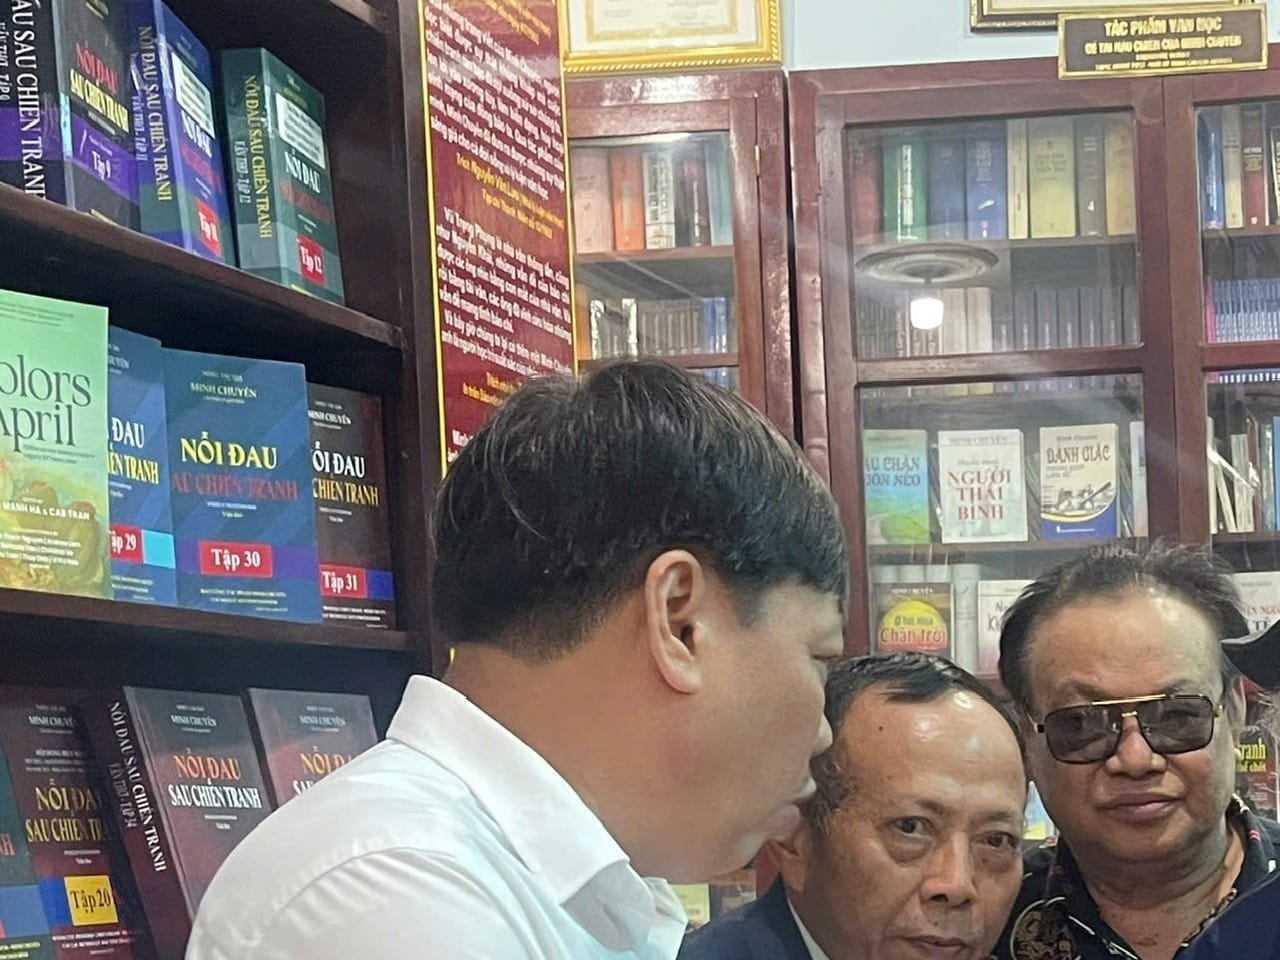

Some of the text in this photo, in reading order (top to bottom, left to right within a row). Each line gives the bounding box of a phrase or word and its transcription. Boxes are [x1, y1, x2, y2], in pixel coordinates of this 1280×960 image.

[1105, 20, 1128, 37] TÁC
[1130, 16, 1167, 35] PHẨM
[1196, 17, 1222, 34] HỌC
[13, 30, 37, 69] SAU
[95, 58, 118, 95] ĐAU
[142, 52, 159, 82] ĐAU
[147, 84, 161, 110] SAU
[92, 150, 105, 181] Tập
[153, 155, 173, 201] TRANH
[300, 163, 322, 194] ĐAU
[199, 211, 212, 237] Tập
[256, 196, 273, 239] TRANH
[455, 213, 473, 236] Trọng
[475, 224, 494, 248] Phụng
[452, 230, 476, 256] Nguyễn
[300, 244, 322, 274] Tập 12
[190, 382, 215, 394] MINH
[112, 418, 145, 449] ĐAU
[181, 431, 277, 469] NỖI ĐAU
[332, 452, 365, 478] ĐAU
[245, 476, 299, 501] TRANH
[948, 465, 1011, 486] NGƯỜI
[344, 482, 379, 508] TRANH
[957, 482, 1003, 502] THÁI
[211, 549, 261, 572] Tập 30
[322, 571, 358, 594] Tập 31
[115, 727, 133, 754] ĐAU
[124, 752, 141, 783] SAU
[174, 747, 241, 781] NỖI ĐAU
[301, 746, 330, 775] NỖI
[35, 778, 69, 811] NỖI
[131, 783, 154, 828] CHIẾN
[168, 778, 262, 810] SAU CHIẾN TRANH
[25, 817, 49, 843] SAU
[144, 827, 167, 872] TRANH
[70, 886, 112, 914] Tập 20
